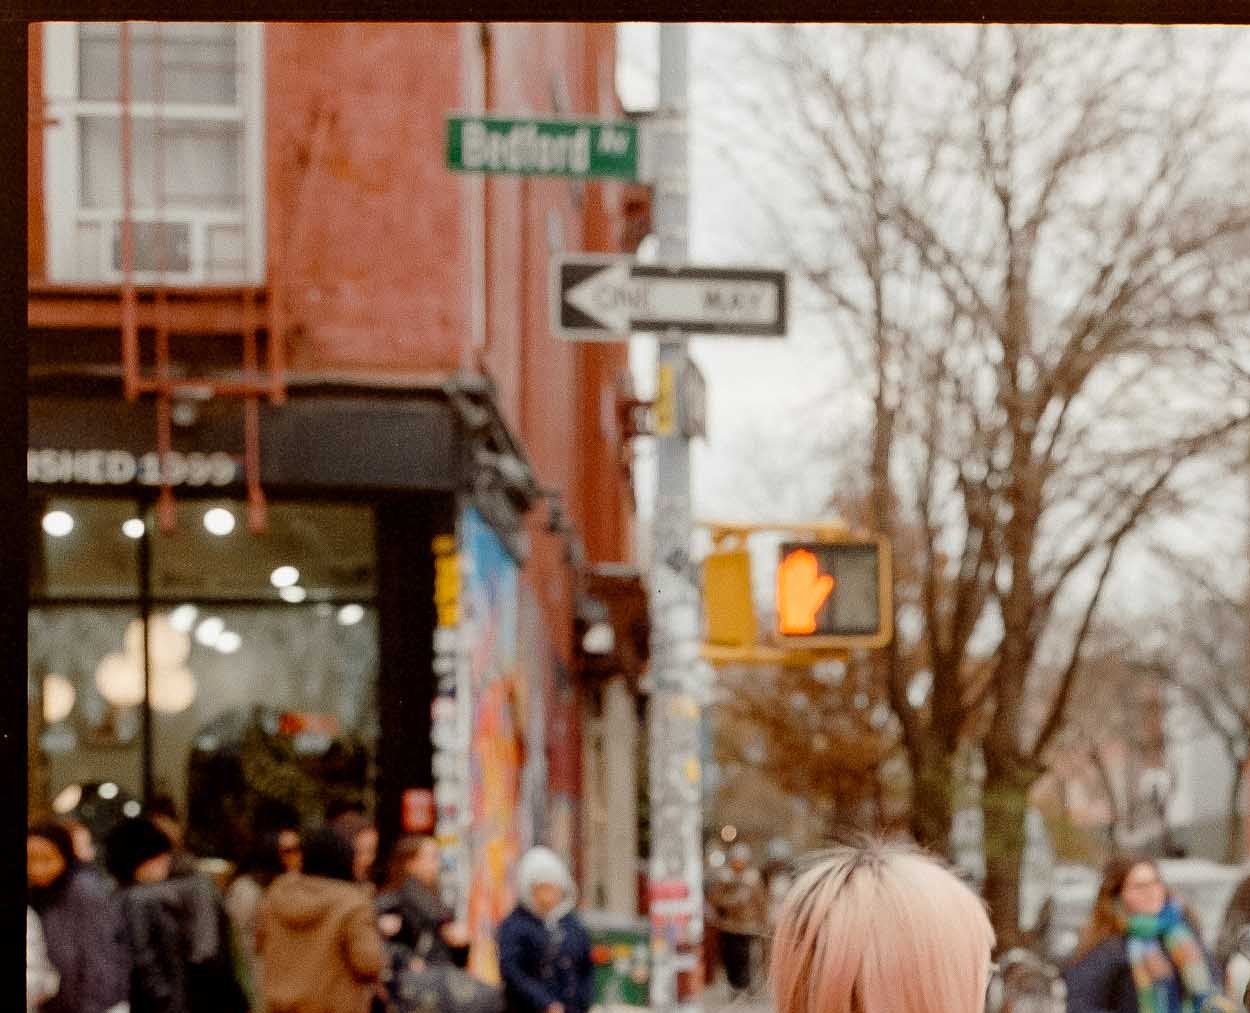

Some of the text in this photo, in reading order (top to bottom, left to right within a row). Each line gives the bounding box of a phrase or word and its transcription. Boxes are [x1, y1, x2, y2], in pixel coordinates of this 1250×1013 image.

[462, 121, 590, 174] Bedford
[592, 283, 766, 315] ONE WAY
